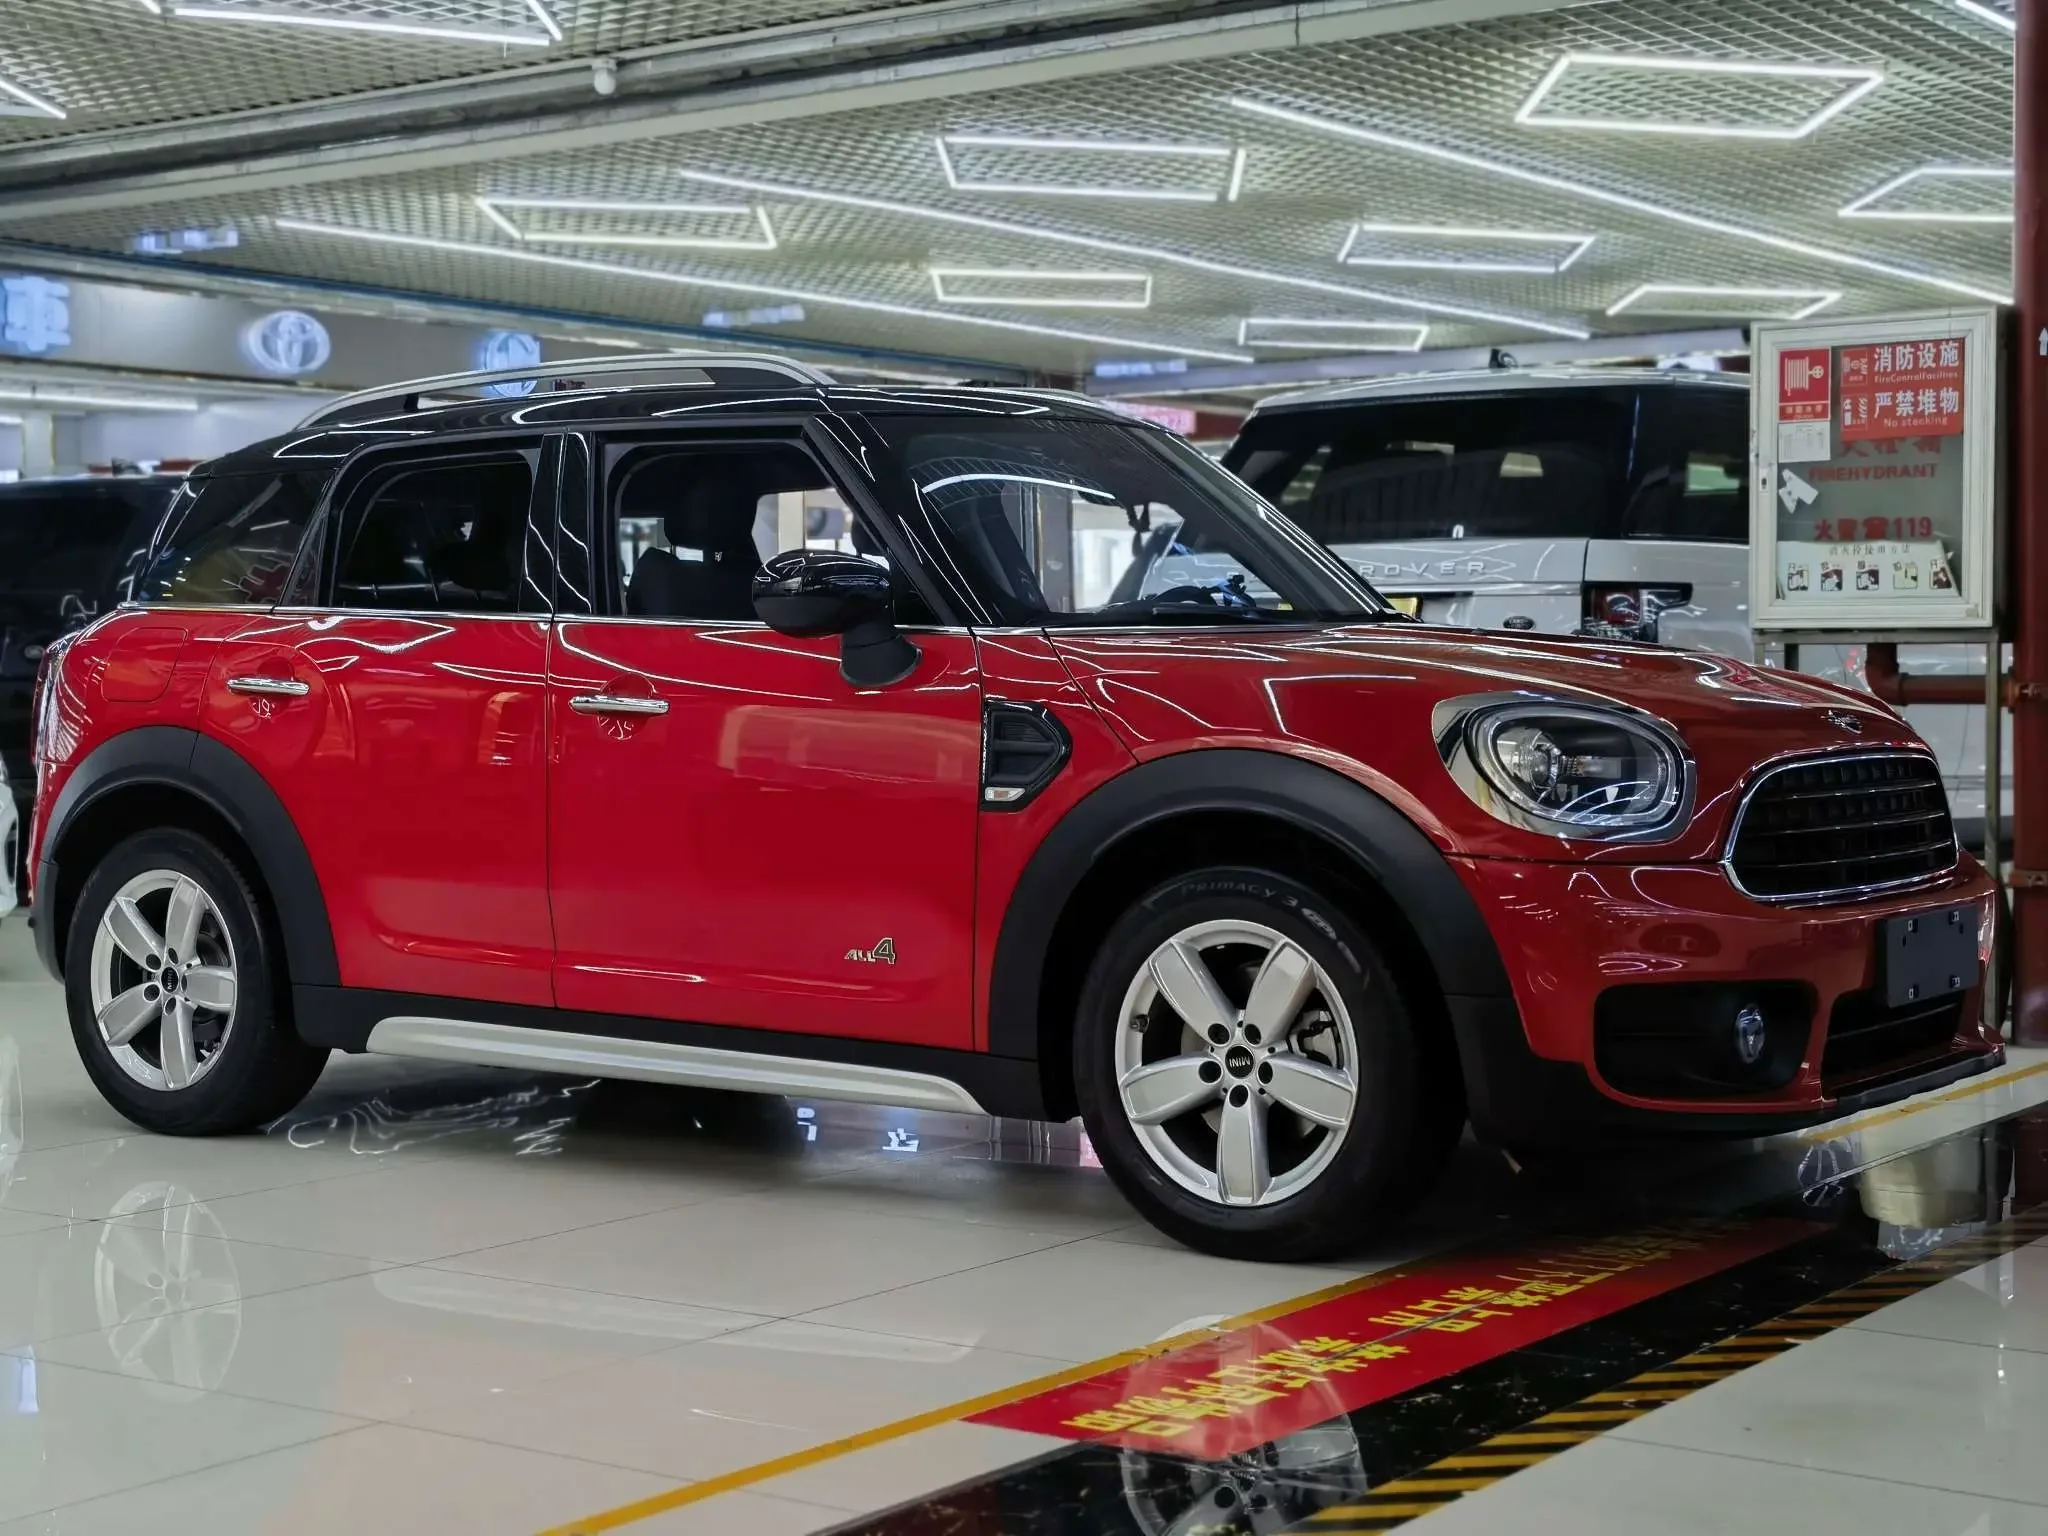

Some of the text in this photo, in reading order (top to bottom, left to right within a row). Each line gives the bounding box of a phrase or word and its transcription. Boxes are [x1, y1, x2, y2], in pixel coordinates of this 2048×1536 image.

[1874, 341, 1959, 372] 消防设施
[1874, 387, 1959, 418] 严禁堆物
[1884, 418, 1898, 428] No
[1358, 560, 1485, 577] ROVER
[1181, 880, 1299, 909] PRIMACY 3
[844, 937, 896, 965] ALL4
[1229, 1056, 1251, 1068] MINI
[1061, 1336, 1411, 1438] 禁放任何物品
